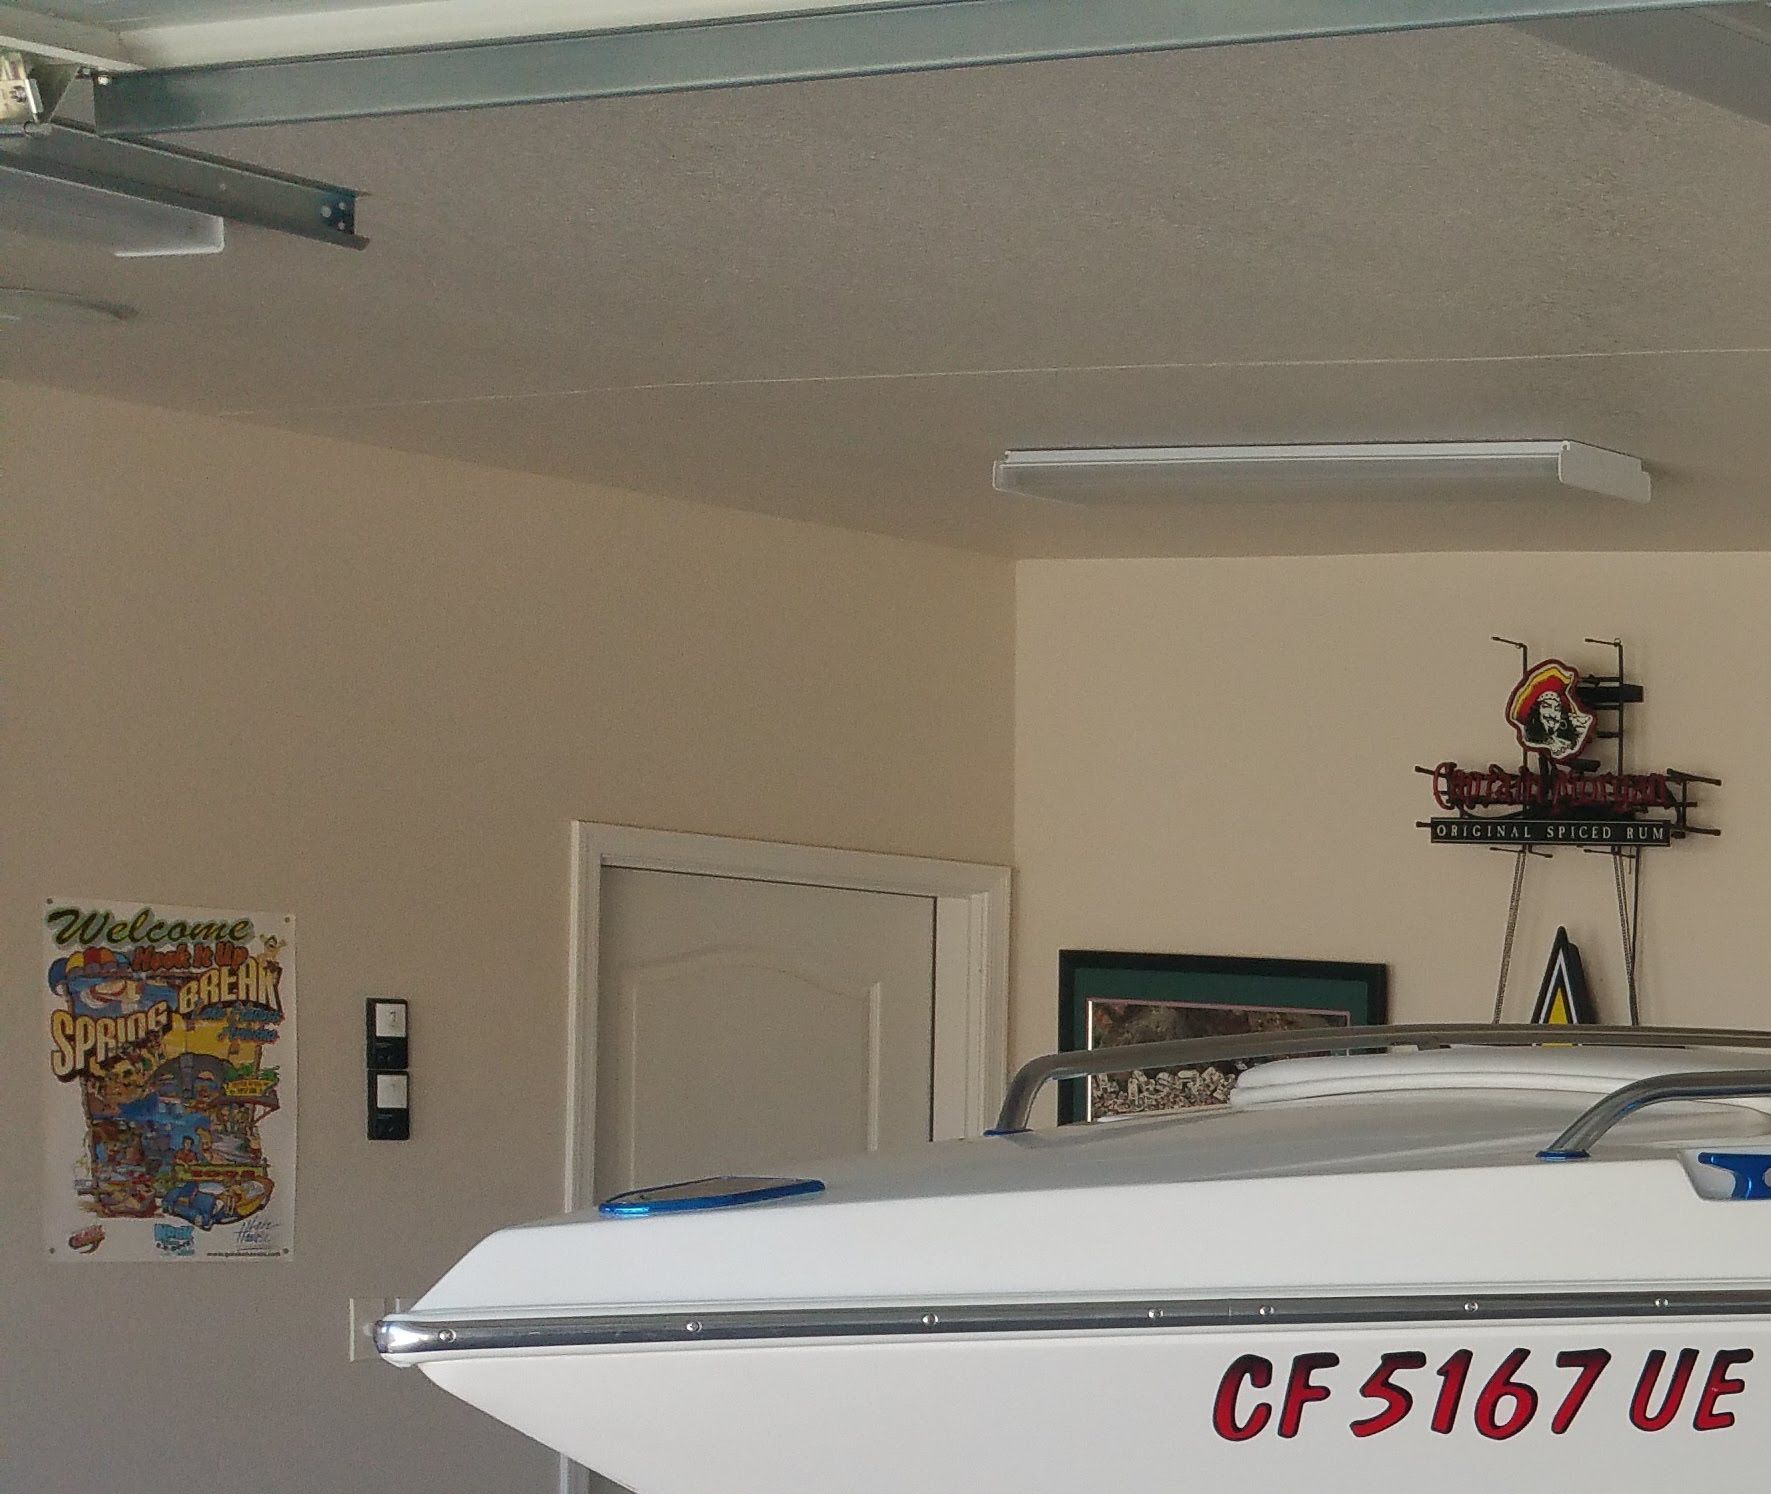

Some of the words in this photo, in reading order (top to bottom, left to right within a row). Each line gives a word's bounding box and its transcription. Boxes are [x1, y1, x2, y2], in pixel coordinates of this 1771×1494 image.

[1433, 762, 1541, 810] Captain
[1553, 769, 1670, 815] Morgan
[1436, 824, 1532, 839] ORIGINAL
[1546, 825, 1612, 840] SPICED
[1627, 825, 1665, 840] RUM
[48, 907, 251, 946] Welcome
[179, 956, 282, 1015] BREAK
[51, 1002, 172, 1082] SPRING
[1212, 1353, 1341, 1442] CF
[1349, 1348, 1612, 1441] 5167
[1629, 1348, 1754, 1432] UE
